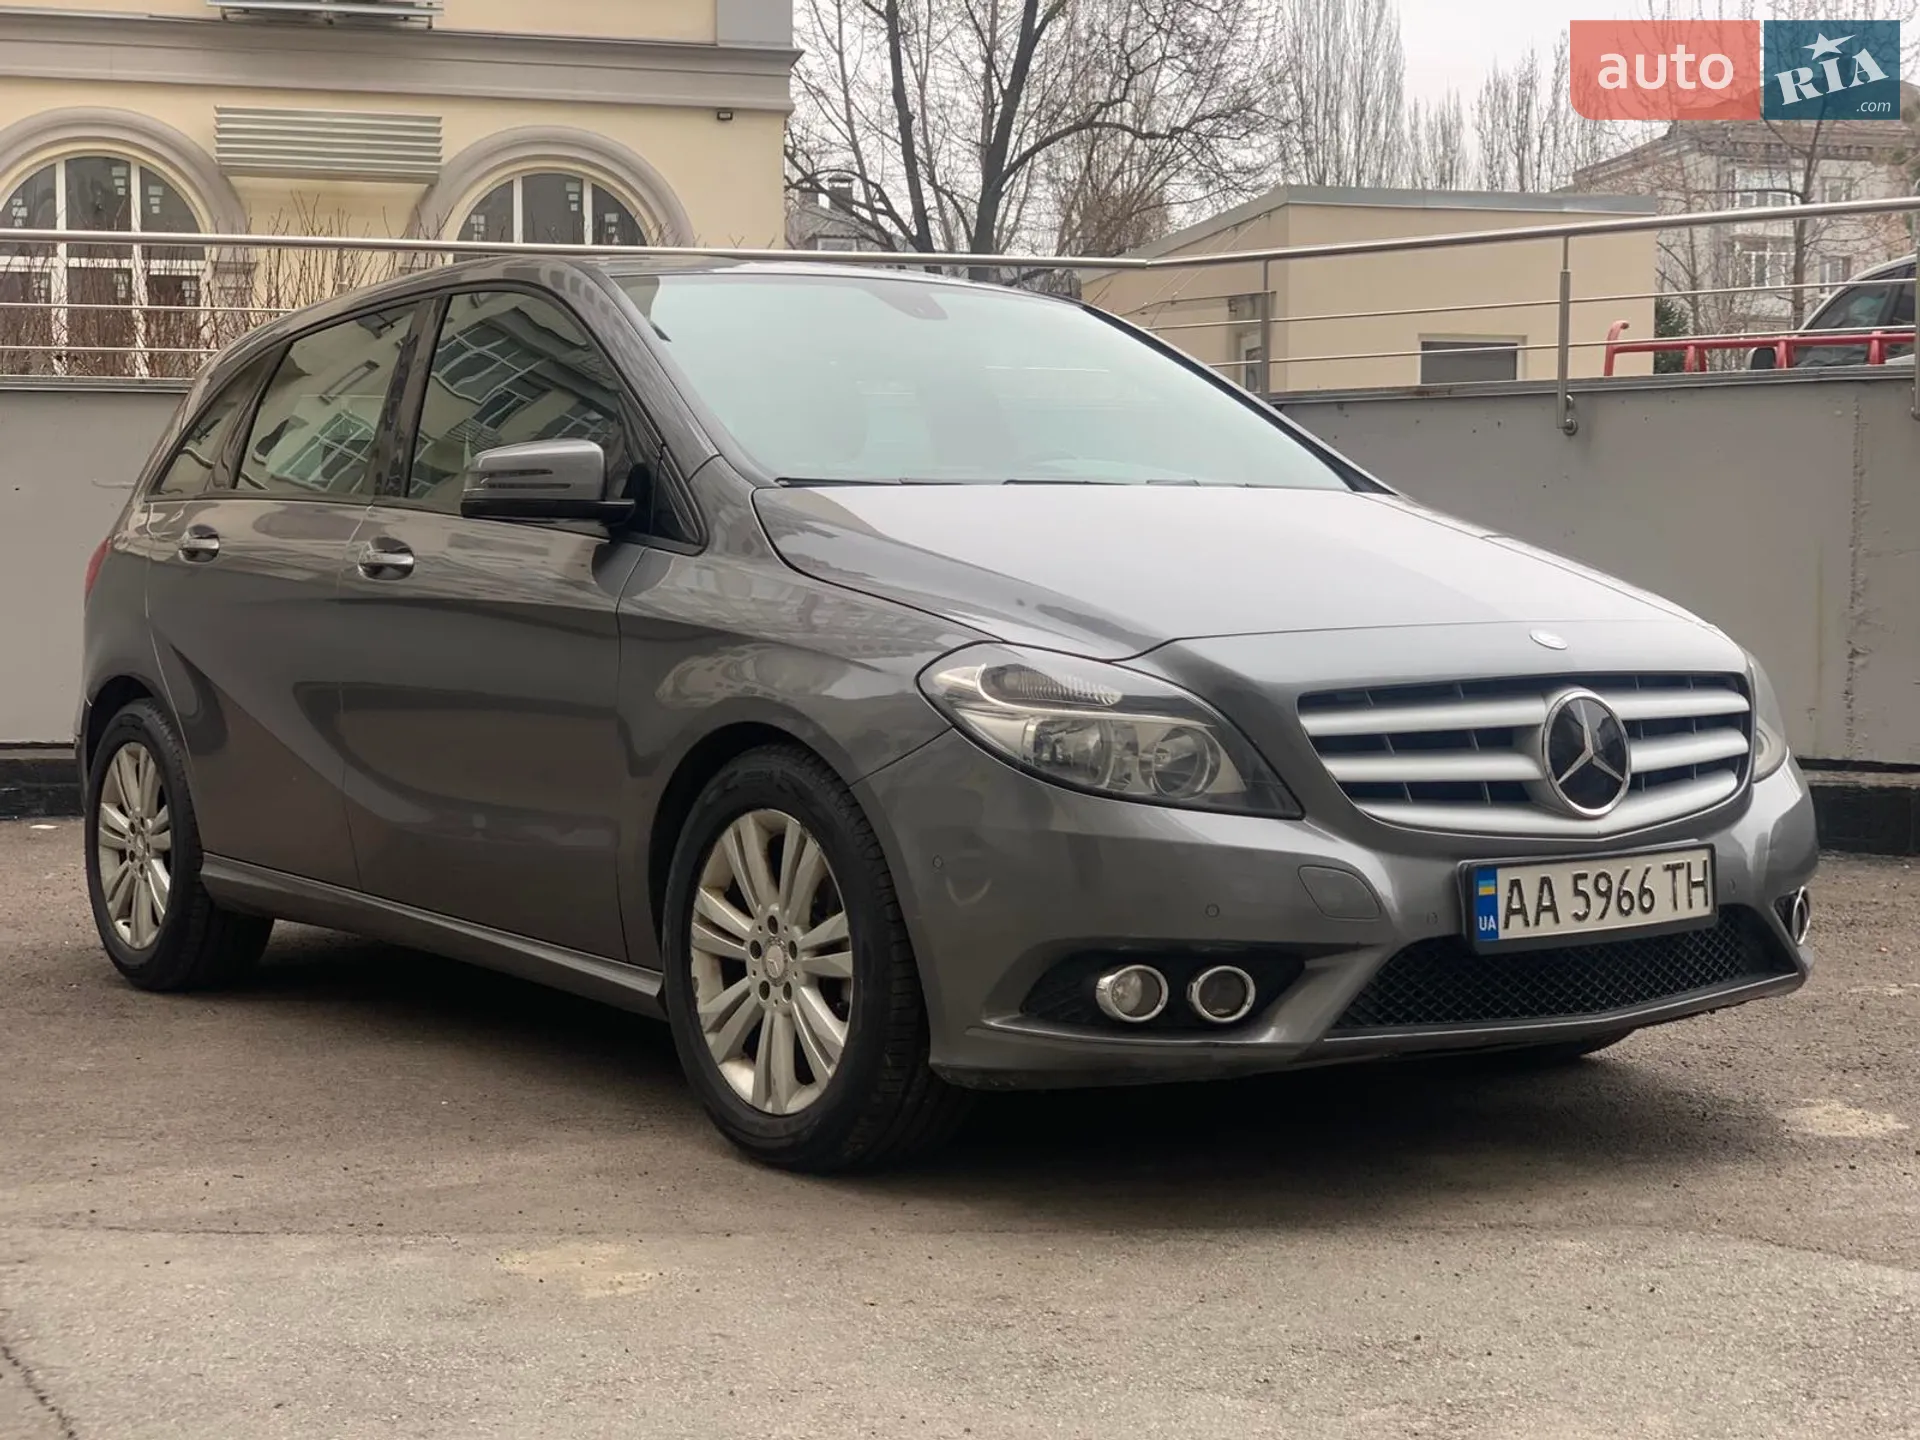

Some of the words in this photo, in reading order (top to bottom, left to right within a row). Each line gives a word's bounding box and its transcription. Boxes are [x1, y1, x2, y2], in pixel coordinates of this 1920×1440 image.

[1503, 875, 1560, 930] AA
[1572, 865, 1655, 922] 5966
[1662, 859, 1708, 911] TH
[1478, 916, 1496, 932] UA
